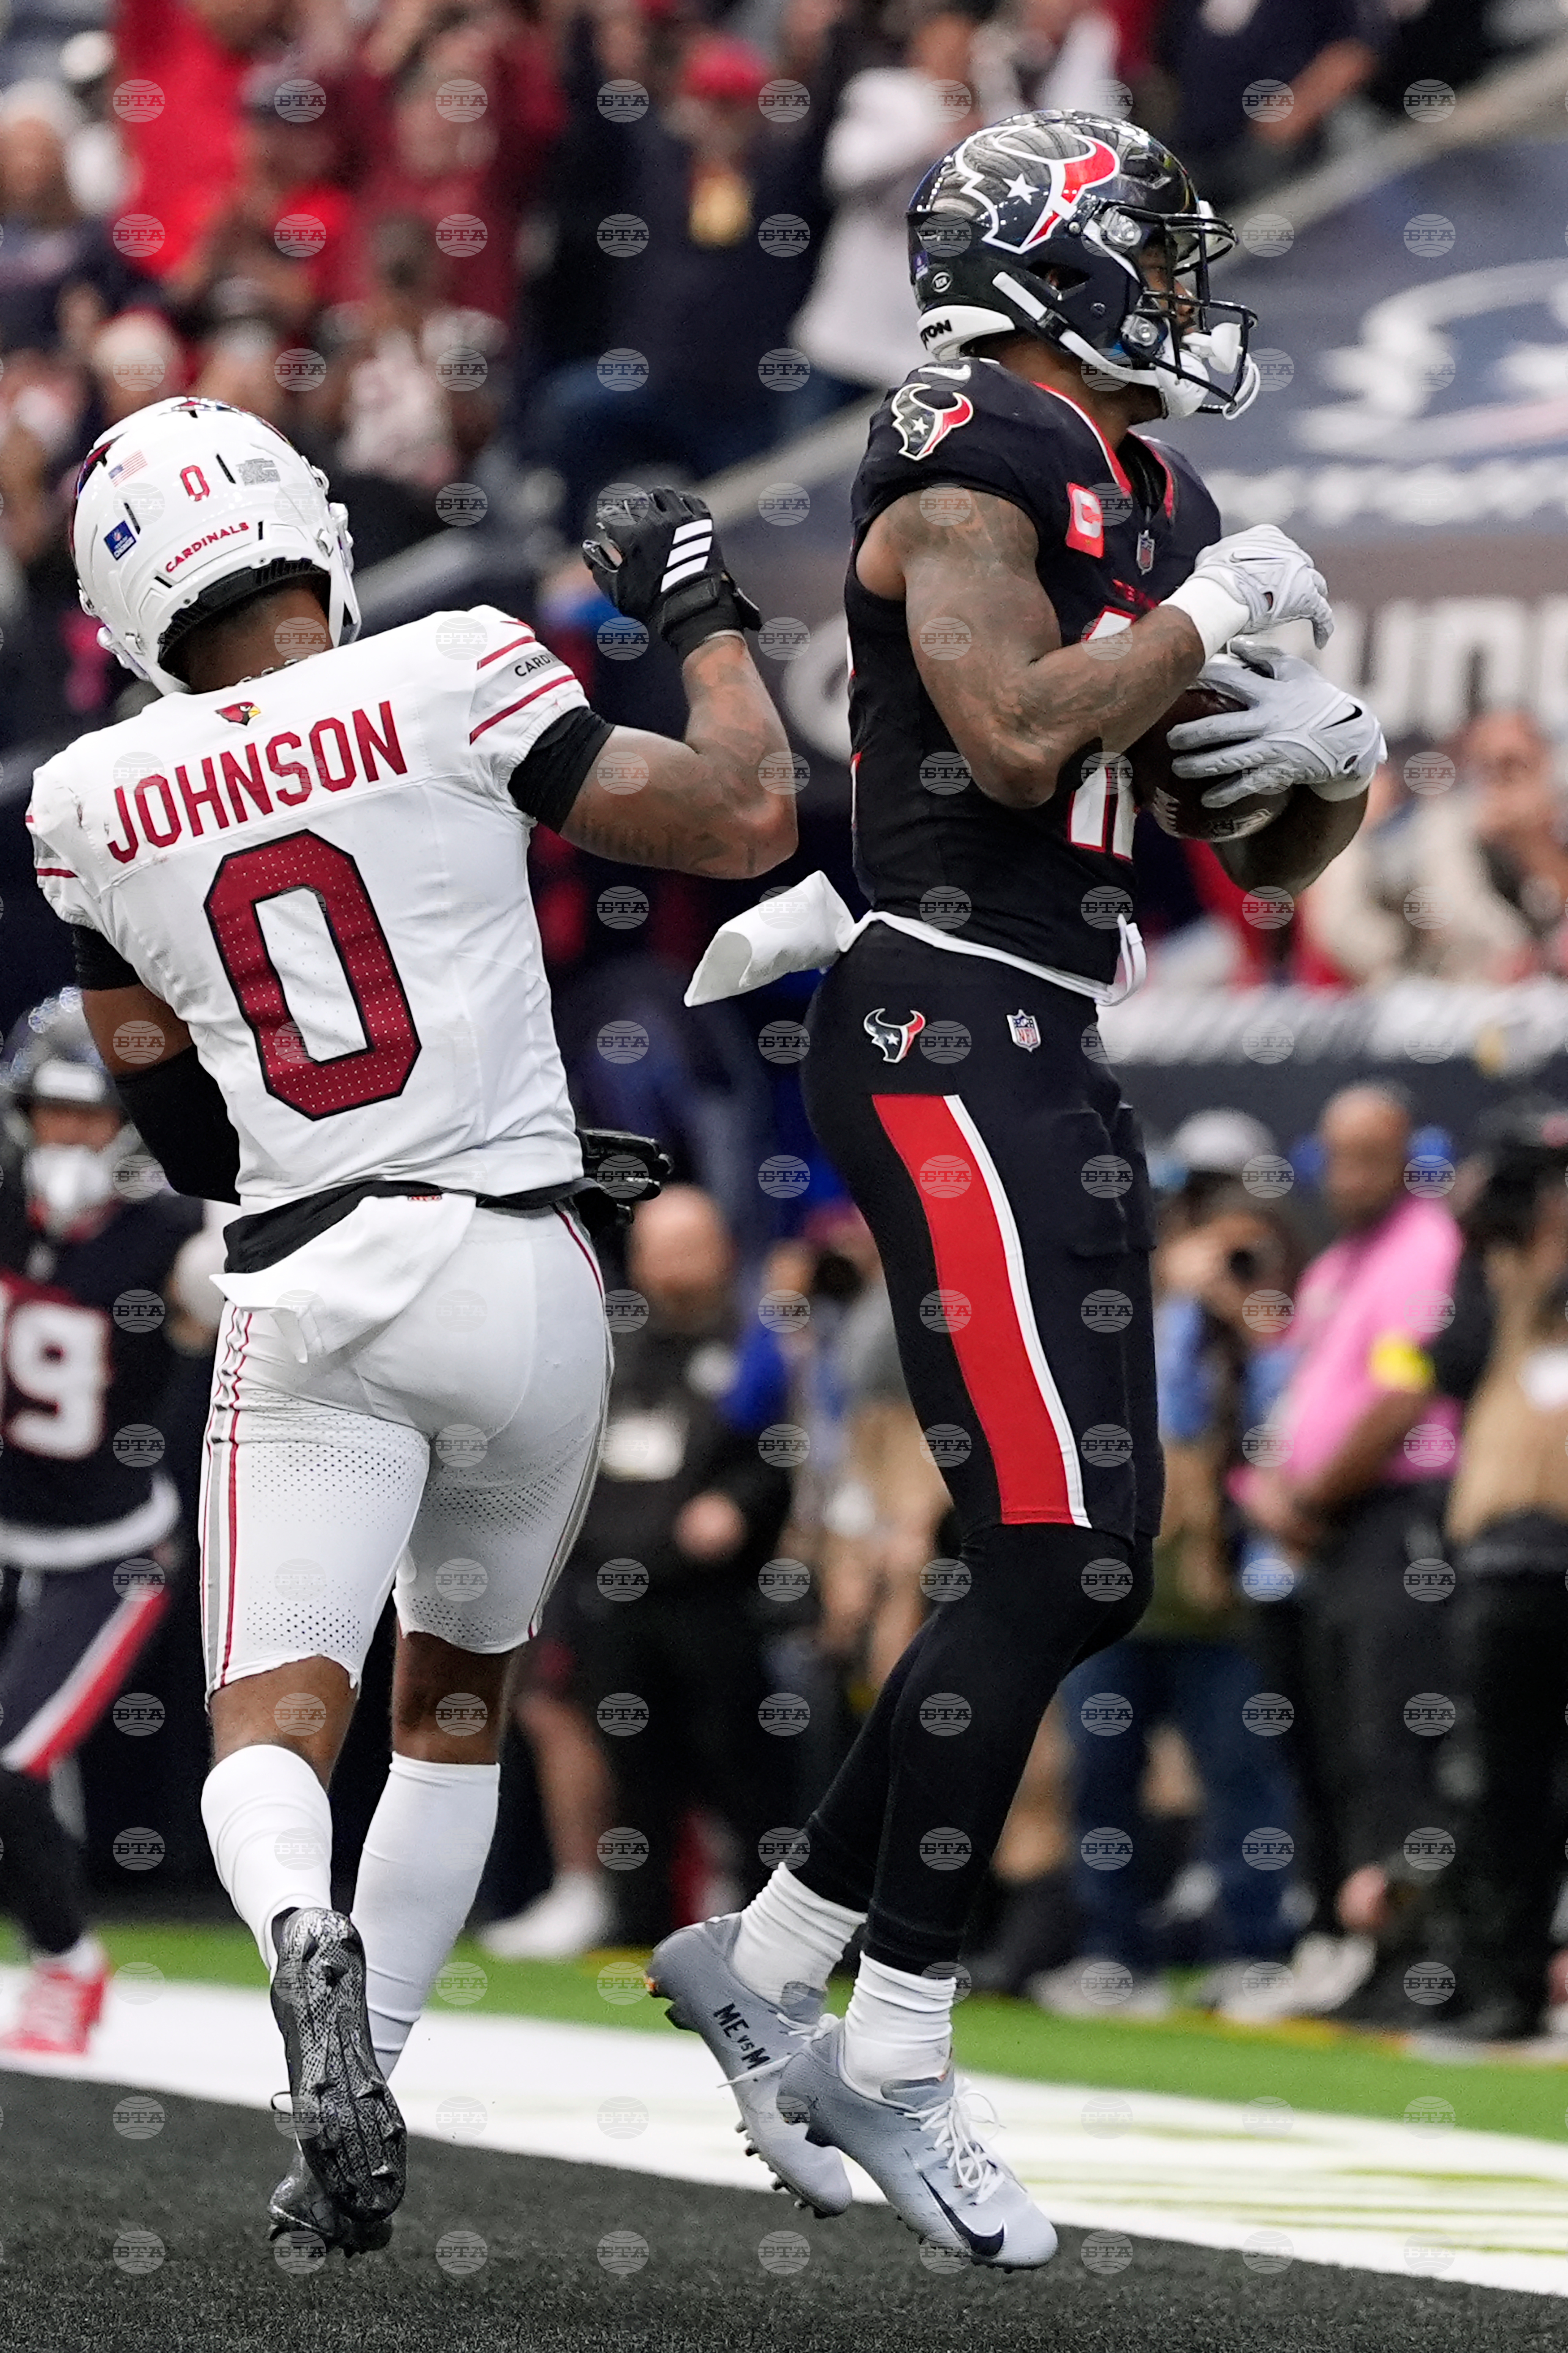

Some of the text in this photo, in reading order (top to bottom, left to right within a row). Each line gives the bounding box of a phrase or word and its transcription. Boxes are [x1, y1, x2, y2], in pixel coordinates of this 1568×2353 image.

[920, 319, 953, 351] TON
[180, 464, 211, 502] 0
[1071, 488, 1103, 539] C
[165, 522, 249, 573] CARDINALS
[107, 701, 408, 864] JOHNSON
[203, 828, 423, 1120] 0
[0, 1273, 113, 1462] 9
[713, 2002, 750, 2038] ME
[741, 2047, 771, 2076] M
